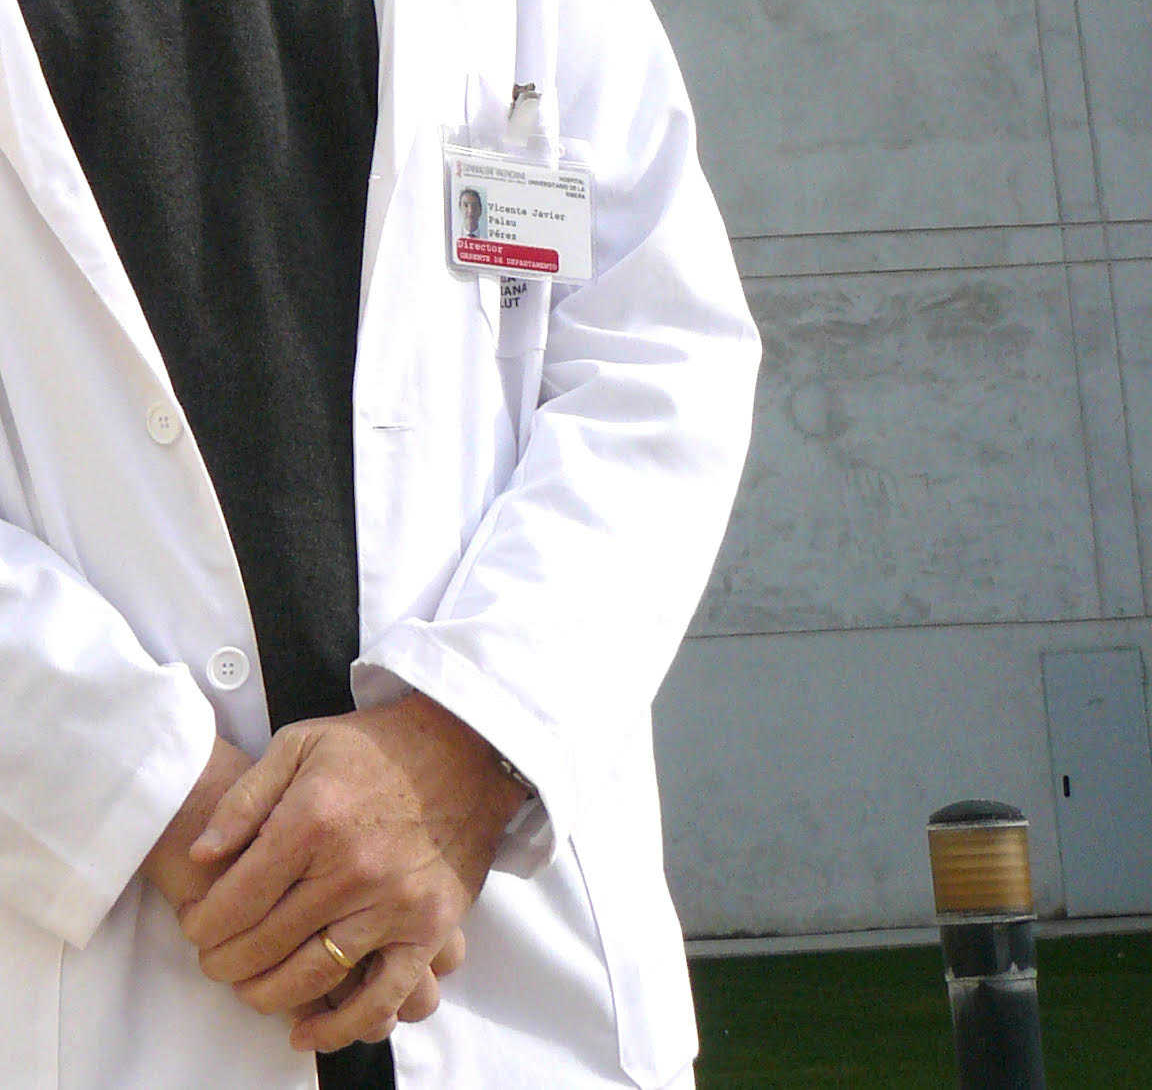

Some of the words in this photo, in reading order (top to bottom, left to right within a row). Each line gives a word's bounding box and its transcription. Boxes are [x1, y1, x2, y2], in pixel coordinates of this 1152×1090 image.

[488, 202, 527, 215] Vicente
[532, 209, 567, 221] Javier
[488, 229, 517, 240] Pérez
[457, 240, 503, 253] Director
